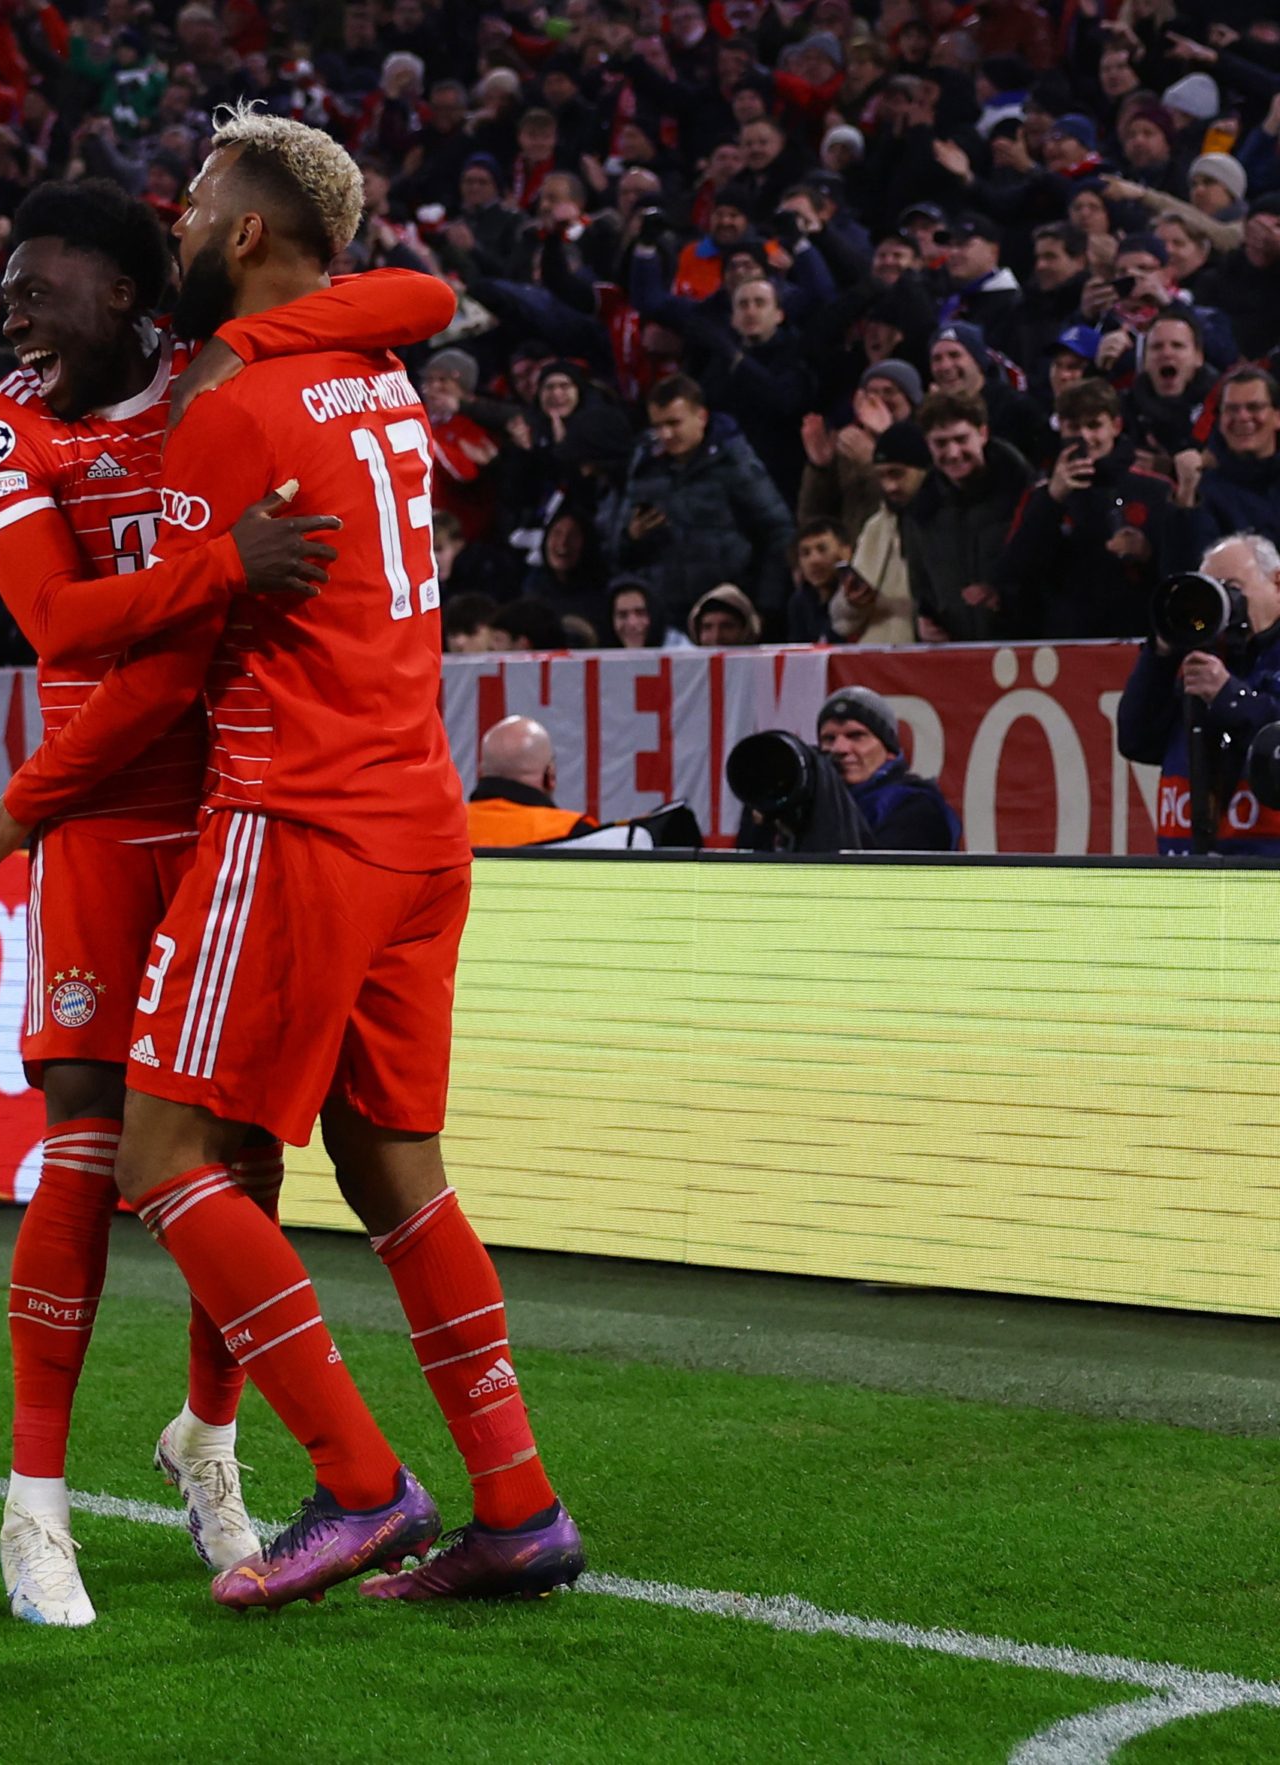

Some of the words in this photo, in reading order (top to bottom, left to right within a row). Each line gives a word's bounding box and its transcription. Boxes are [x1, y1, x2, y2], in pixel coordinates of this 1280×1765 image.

[87, 466, 128, 479] adidas
[350, 418, 440, 621] 13
[64, 984, 93, 1002] BAYERN
[55, 1008, 93, 1026] MÜNCHEN
[468, 1374, 519, 1398] adida
